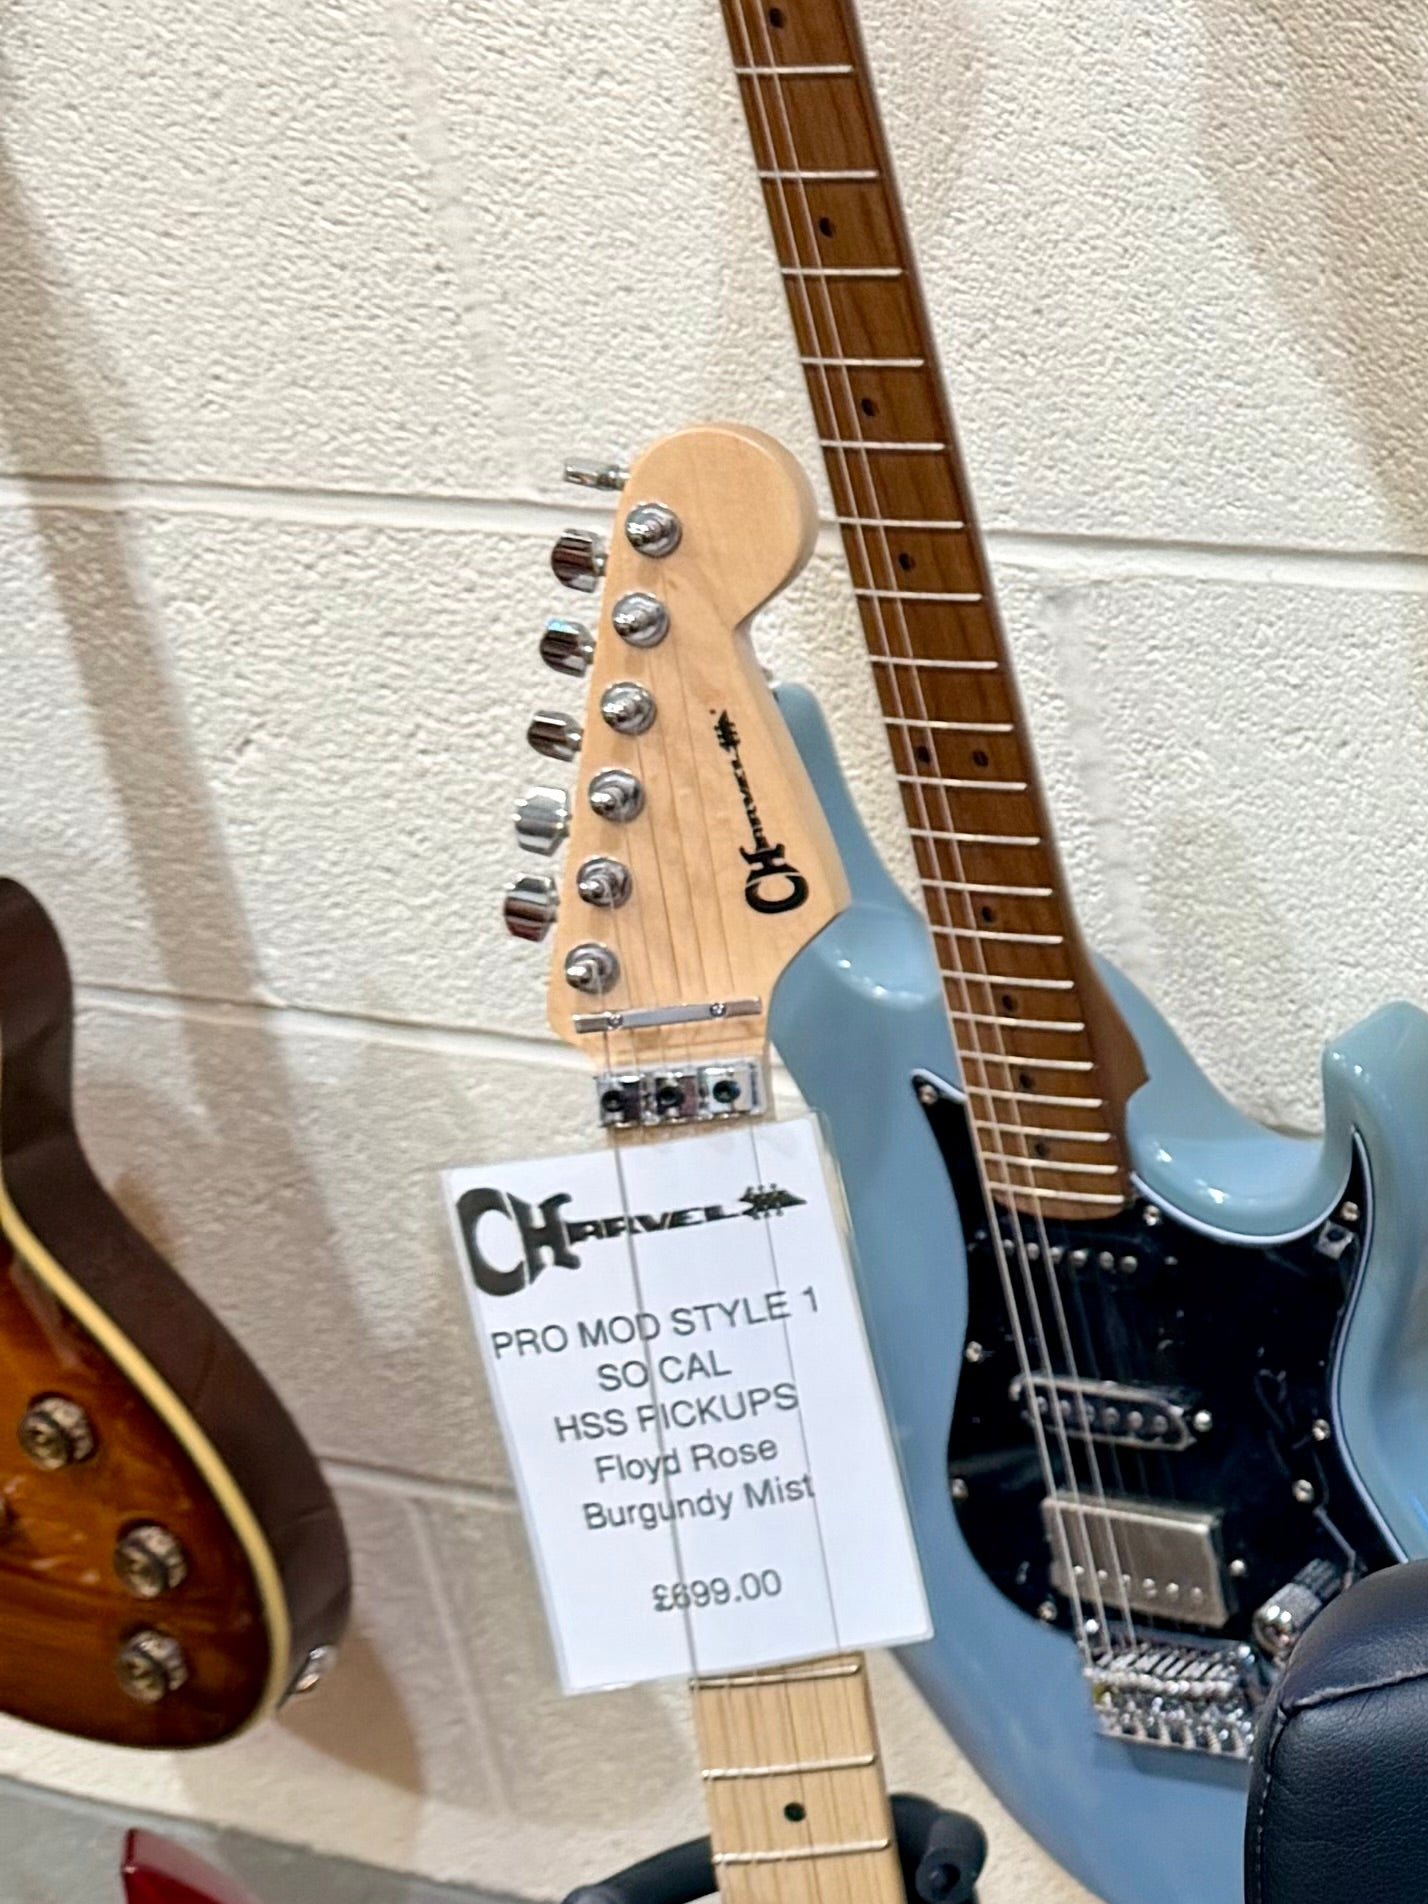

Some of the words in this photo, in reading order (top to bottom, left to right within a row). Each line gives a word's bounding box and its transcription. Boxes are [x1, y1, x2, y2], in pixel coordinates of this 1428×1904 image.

[490, 1323, 569, 1360] PRO
[577, 1312, 661, 1348] MOD
[671, 1290, 792, 1336] STYLE
[802, 1285, 818, 1313] 1
[598, 1359, 649, 1392] SO
[658, 1349, 733, 1384] CAL
[554, 1408, 629, 1443] HSS
[636, 1382, 800, 1433] PICKUPS
[594, 1447, 682, 1485] Floyd
[689, 1438, 779, 1472] Rose
[582, 1487, 734, 1531] Burgundy
[742, 1472, 816, 1510] Mist
